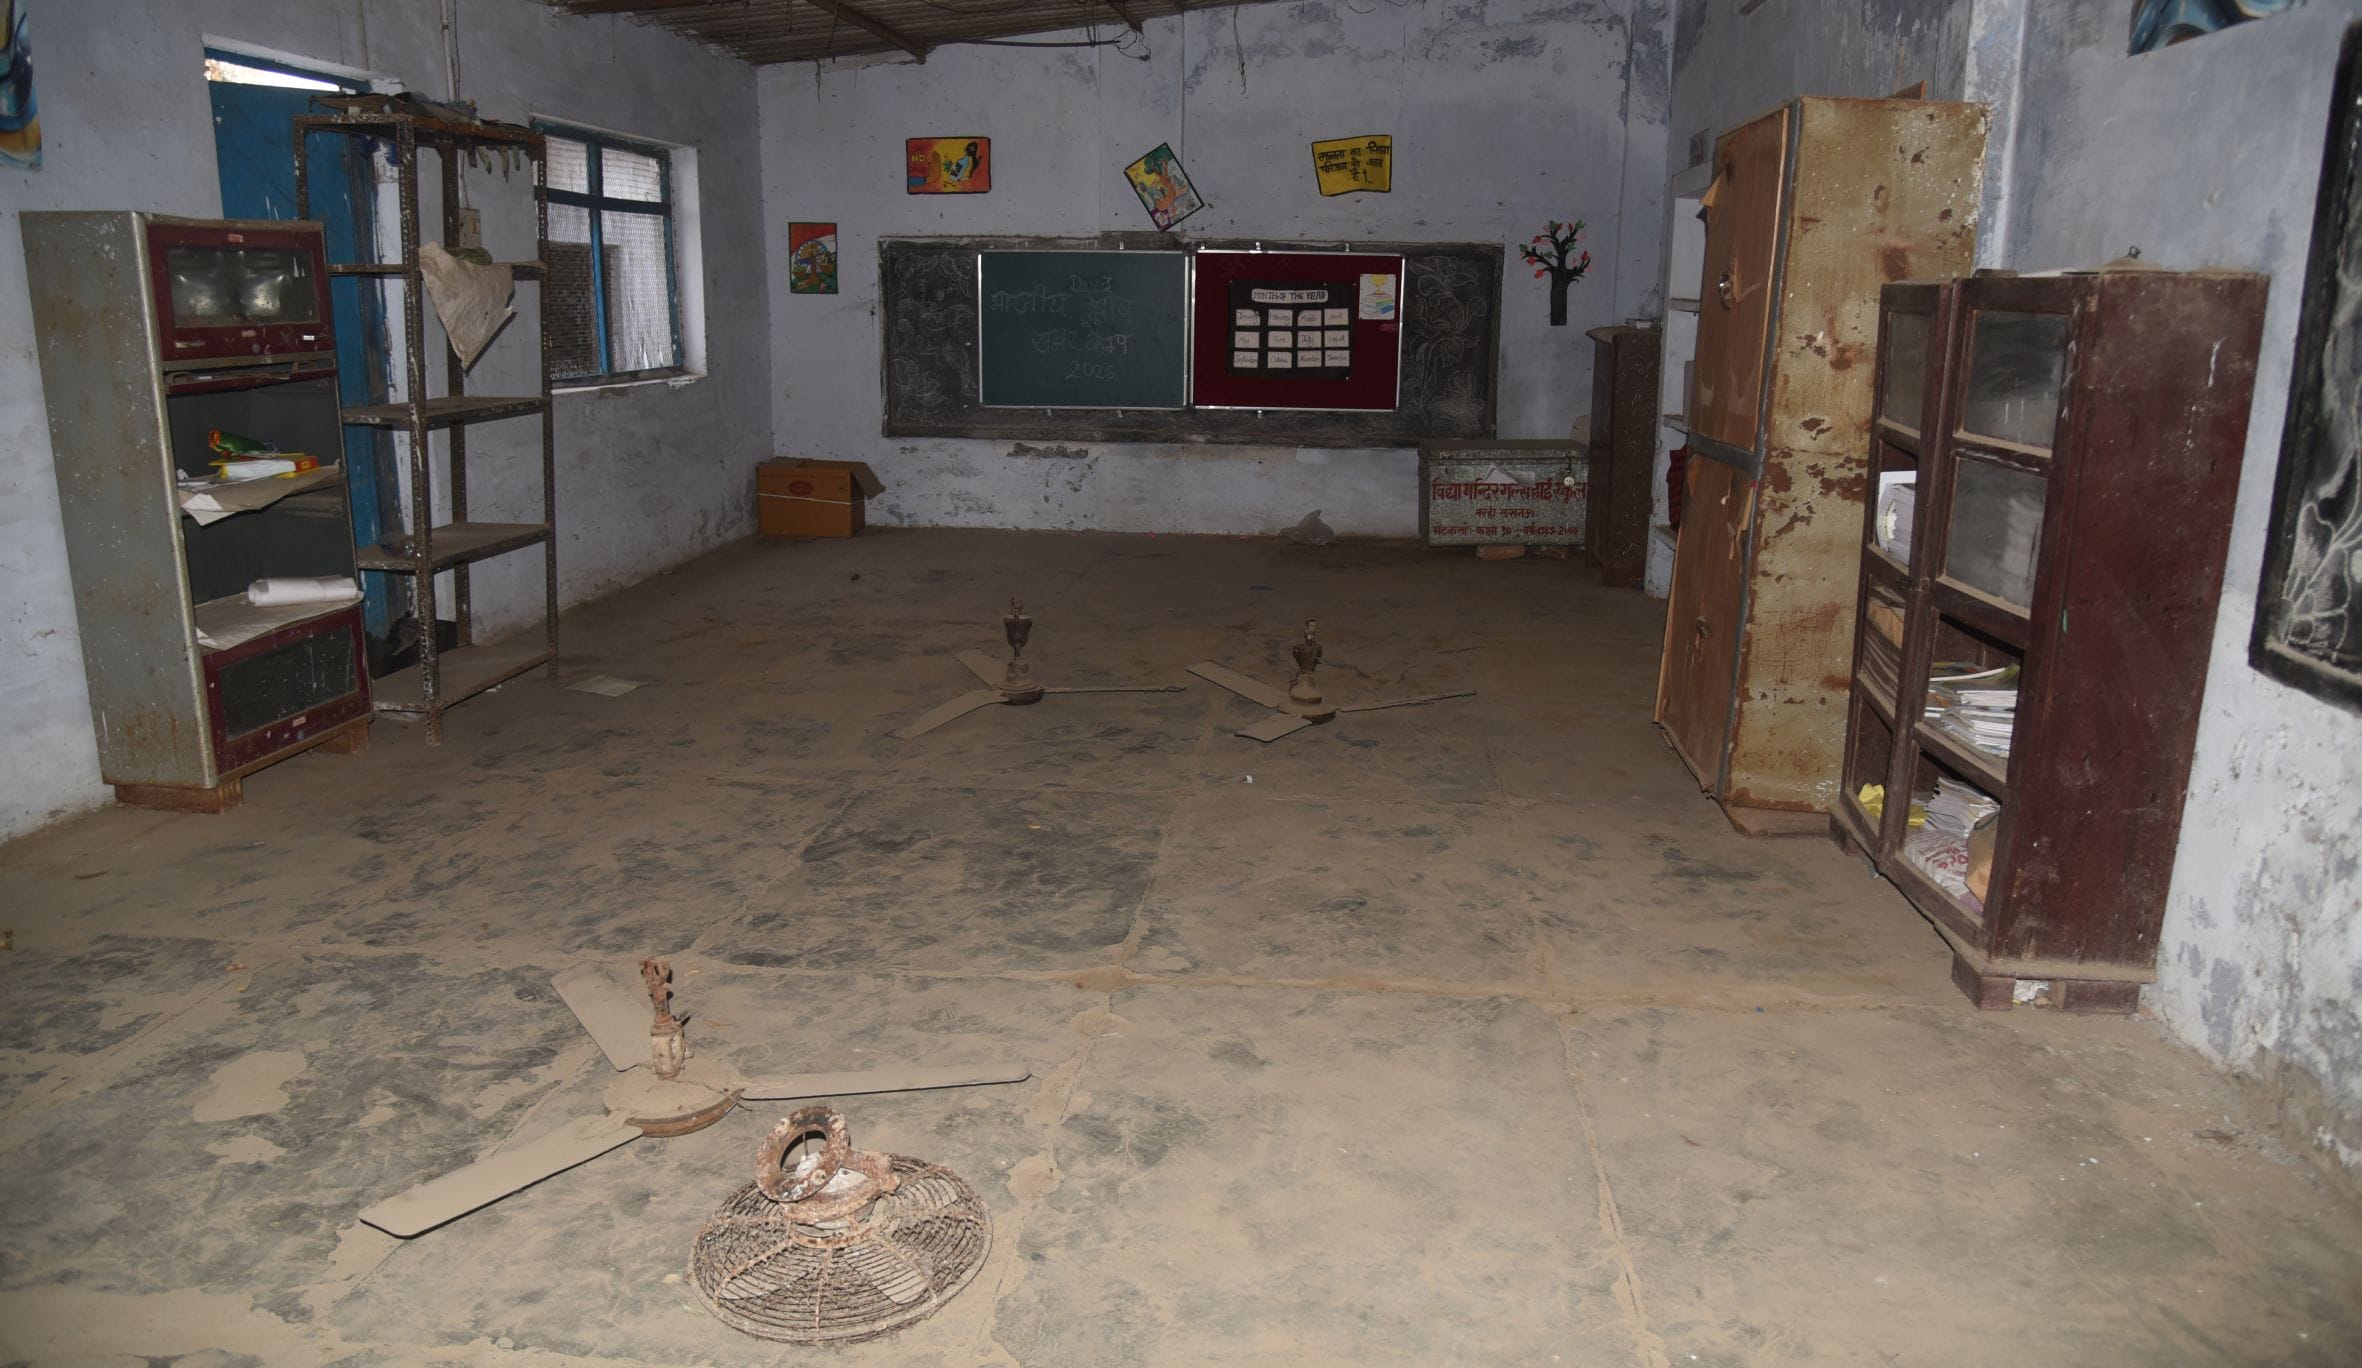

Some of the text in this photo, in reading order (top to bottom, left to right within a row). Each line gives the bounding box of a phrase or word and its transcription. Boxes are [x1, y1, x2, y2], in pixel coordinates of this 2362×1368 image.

[1289, 291, 1304, 300] THE
[1305, 290, 1327, 300] YEAR
[1065, 359, 1115, 381] 2026
